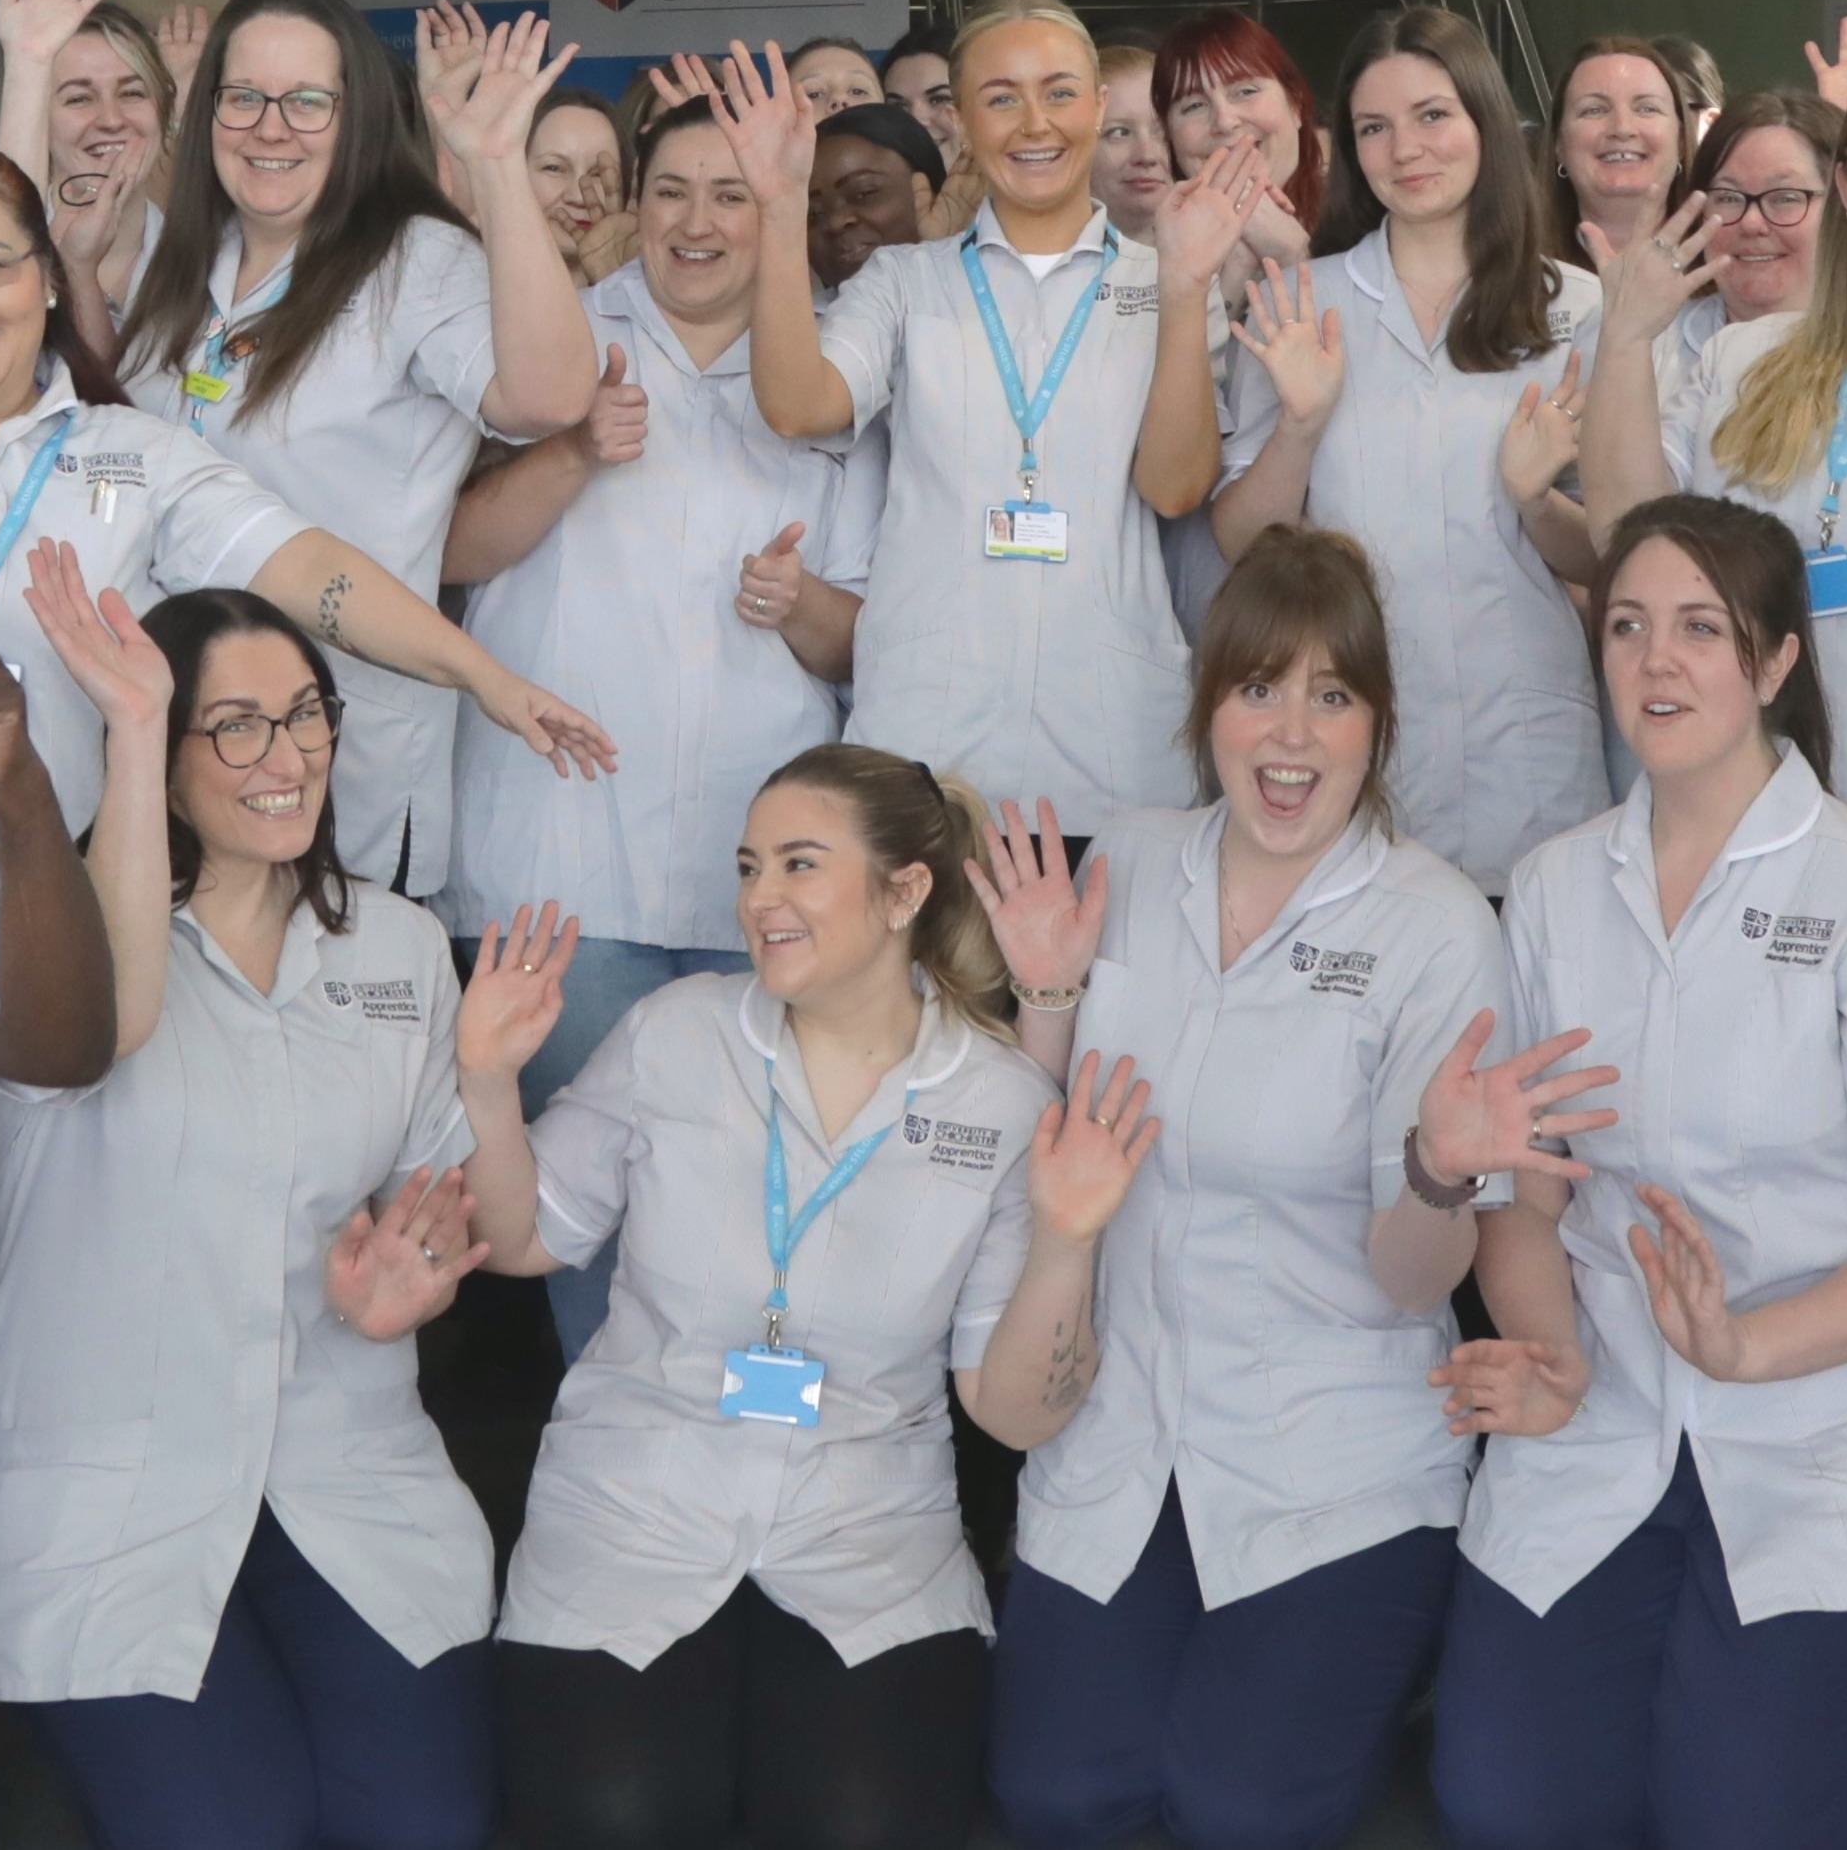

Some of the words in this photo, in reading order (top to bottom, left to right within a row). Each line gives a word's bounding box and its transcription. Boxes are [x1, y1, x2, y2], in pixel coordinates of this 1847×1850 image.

[86, 470, 146, 480] Apprentice
[1769, 940, 1828, 955] Apprentice
[362, 1001, 418, 1012] Apprentice
[932, 1143, 997, 1161] Apprentice
